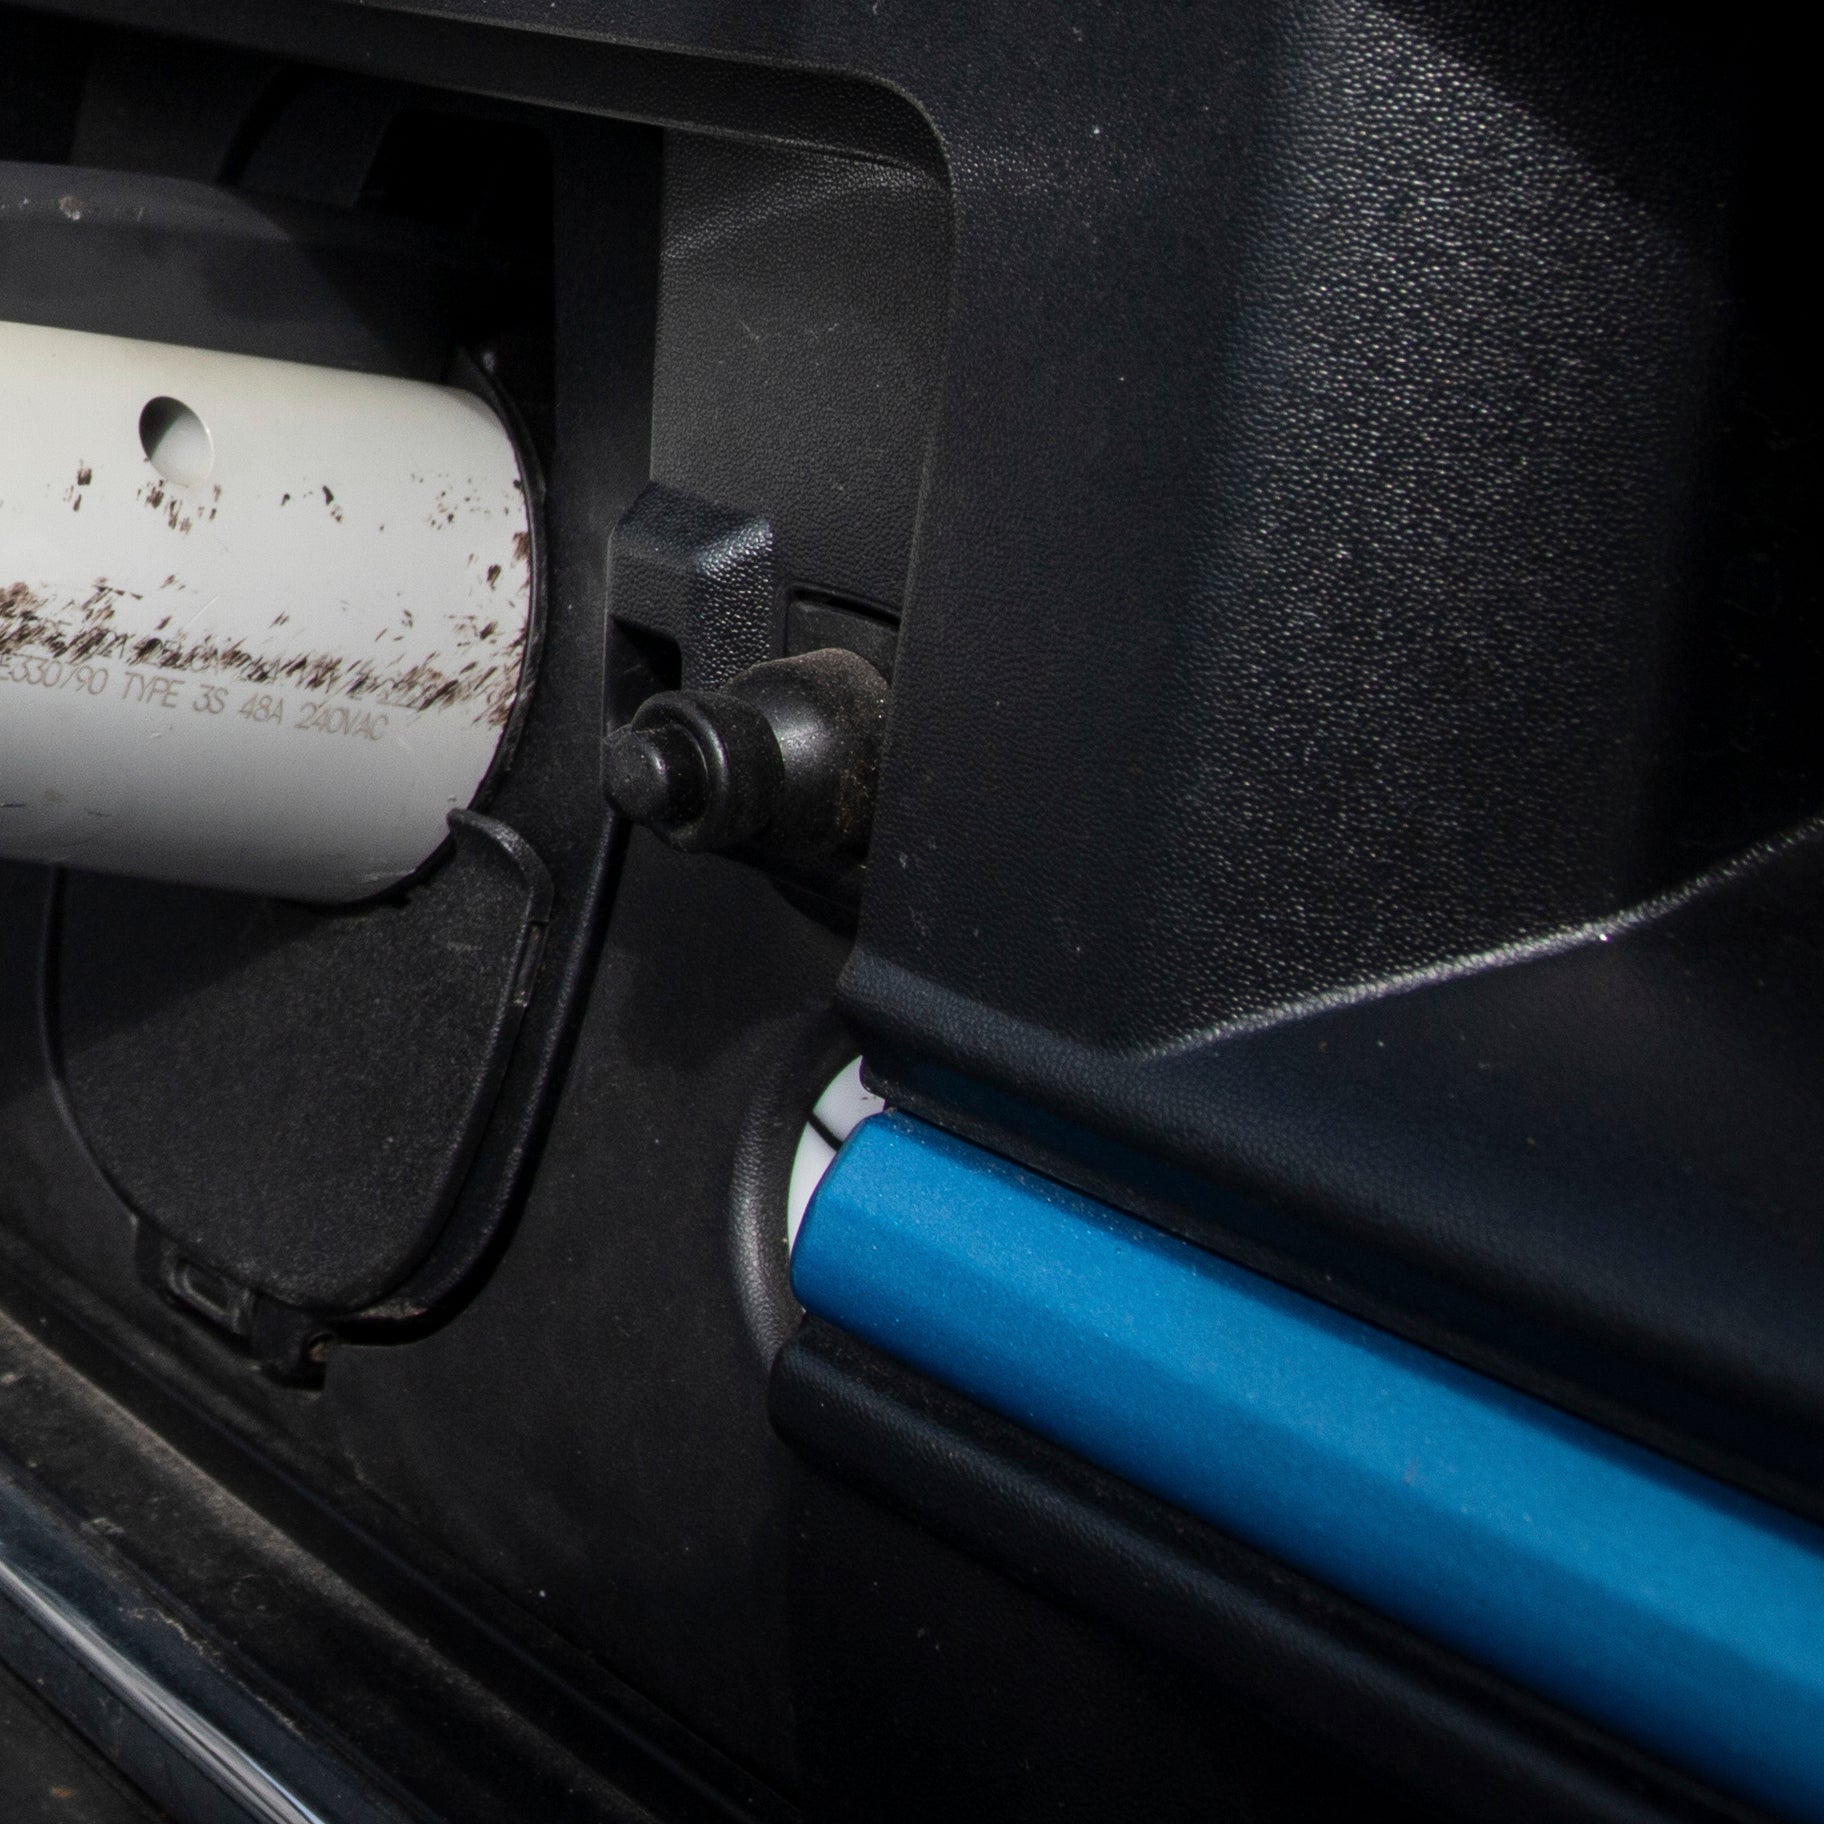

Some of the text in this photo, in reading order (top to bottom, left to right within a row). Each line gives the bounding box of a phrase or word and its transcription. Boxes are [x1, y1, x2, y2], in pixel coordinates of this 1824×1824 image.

[121, 672, 185, 709] TYPE
[192, 683, 229, 715] 3S
[238, 693, 285, 725] 48A
[293, 701, 391, 742] 240VAC
